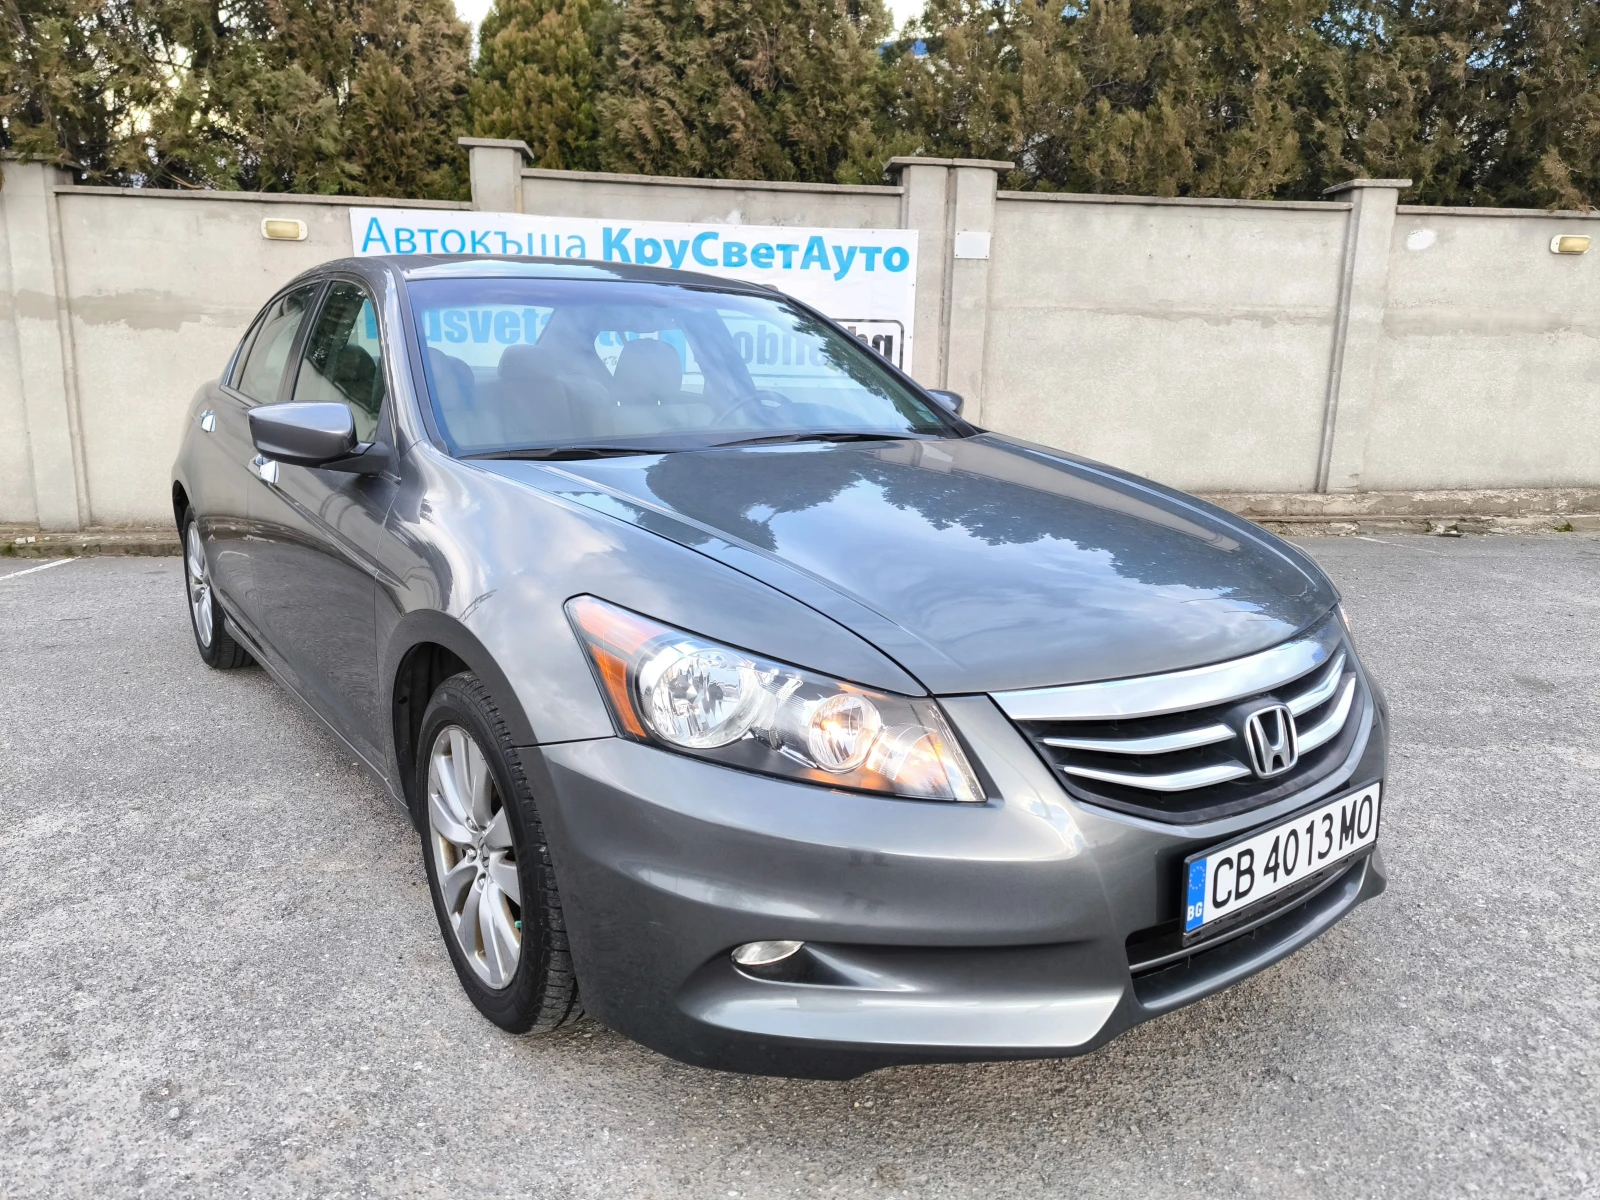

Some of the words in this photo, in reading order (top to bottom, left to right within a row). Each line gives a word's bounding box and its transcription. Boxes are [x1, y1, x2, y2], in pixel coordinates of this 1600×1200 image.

[601, 226, 910, 282] КруСветАуто
[1263, 813, 1334, 884] 4013
[1186, 901, 1204, 922] BG
